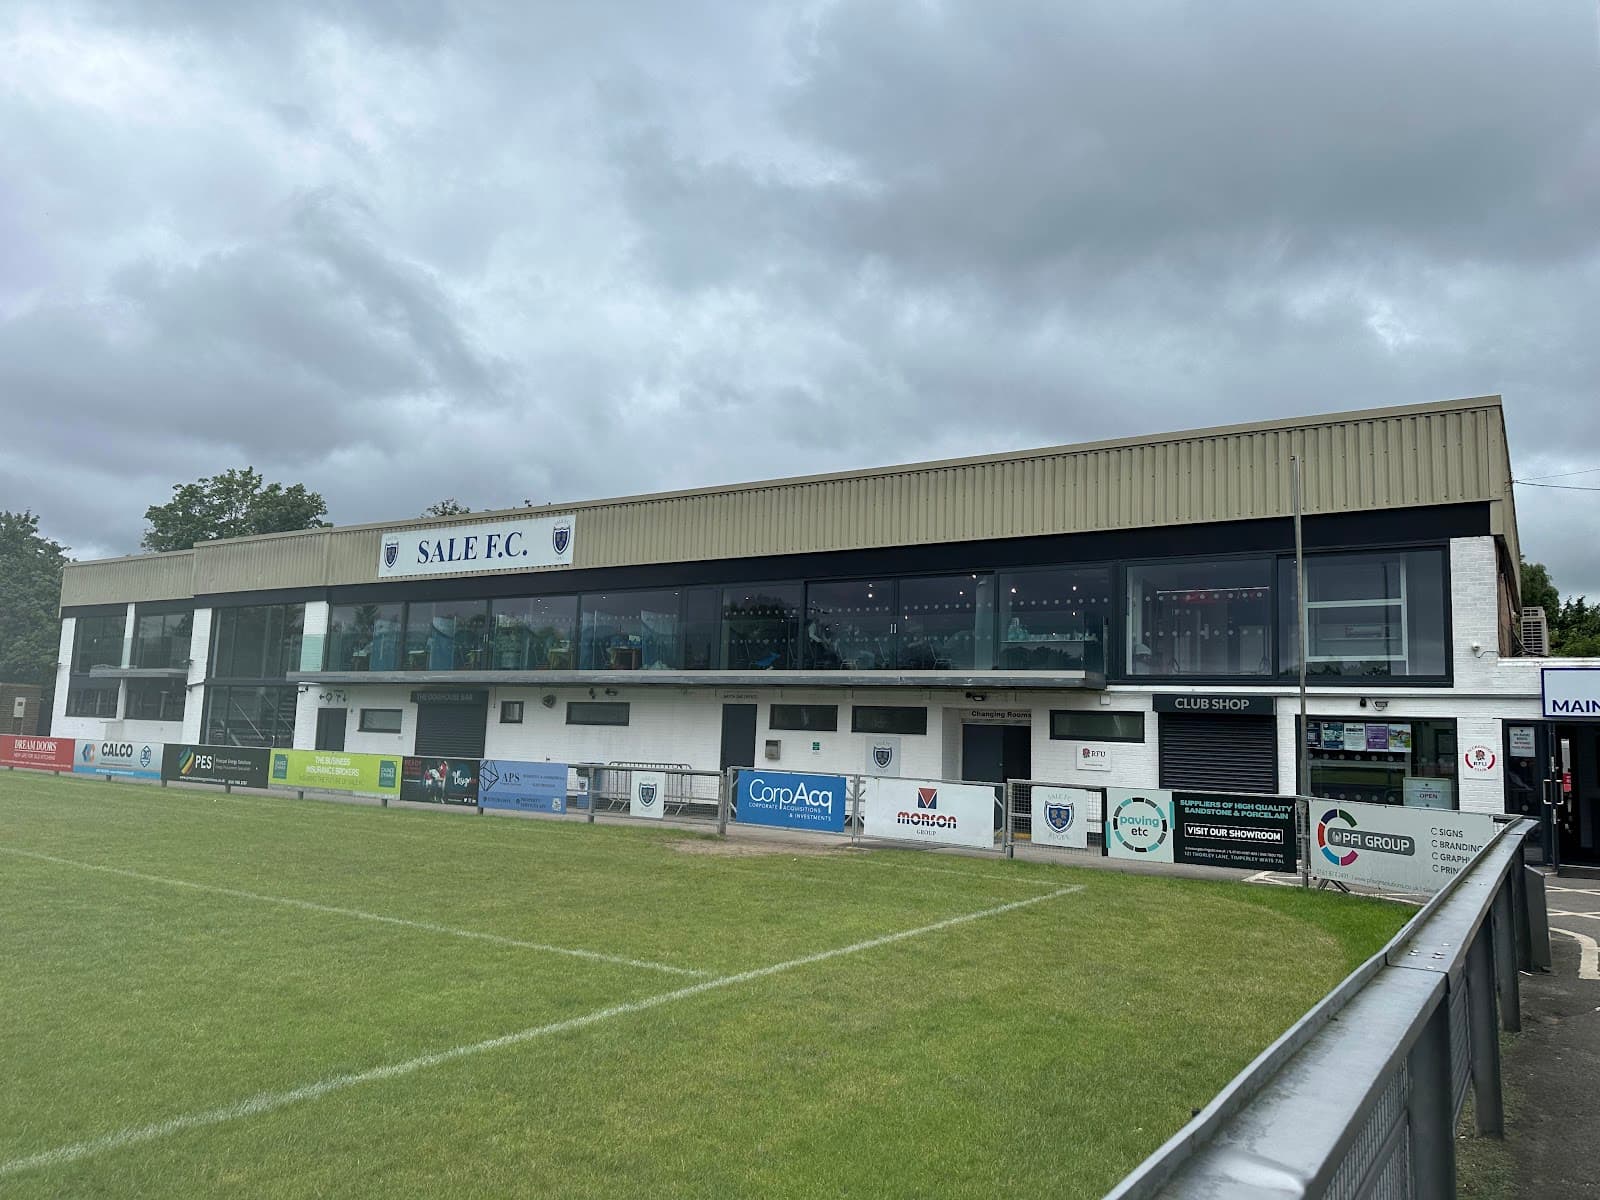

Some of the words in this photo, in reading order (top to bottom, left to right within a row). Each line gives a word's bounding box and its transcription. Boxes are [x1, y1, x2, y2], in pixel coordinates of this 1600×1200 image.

[417, 536, 478, 564] SALE
[485, 531, 528, 559] F.C.
[1175, 698, 1210, 709] CLUB
[1211, 699, 1250, 710] SHOP
[1552, 699, 1600, 713] MAIN
[971, 710, 1006, 719] Changing
[15, 739, 37, 750] DREAM
[37, 741, 57, 751] DOORS
[102, 742, 133, 757] CALCO
[1091, 750, 1106, 758] RFU
[195, 755, 212, 769] PES
[502, 767, 520, 782] APS
[749, 778, 833, 814] CorpAcq
[749, 802, 778, 810] CORPORATE
[783, 805, 821, 813] ACQUISITIONS
[1180, 799, 1221, 808] SUPPLIERS
[1234, 802, 1254, 810] HIGH
[1255, 803, 1293, 812] QUALITY
[794, 814, 832, 822] INVESTMENTS
[1184, 807, 1232, 816] SANDSTONE
[1241, 810, 1289, 820] PORCELAIN
[1120, 815, 1159, 828] paving
[1131, 827, 1149, 836] etc
[1187, 826, 1209, 835] VISIT
[1209, 828, 1228, 837] OUR
[1228, 829, 1281, 841] SHOWROOM
[1439, 828, 1463, 838] SIGNS
[1342, 832, 1361, 846] PFI
[1365, 836, 1410, 851] GROUP
[1441, 865, 1460, 874] PRIN
